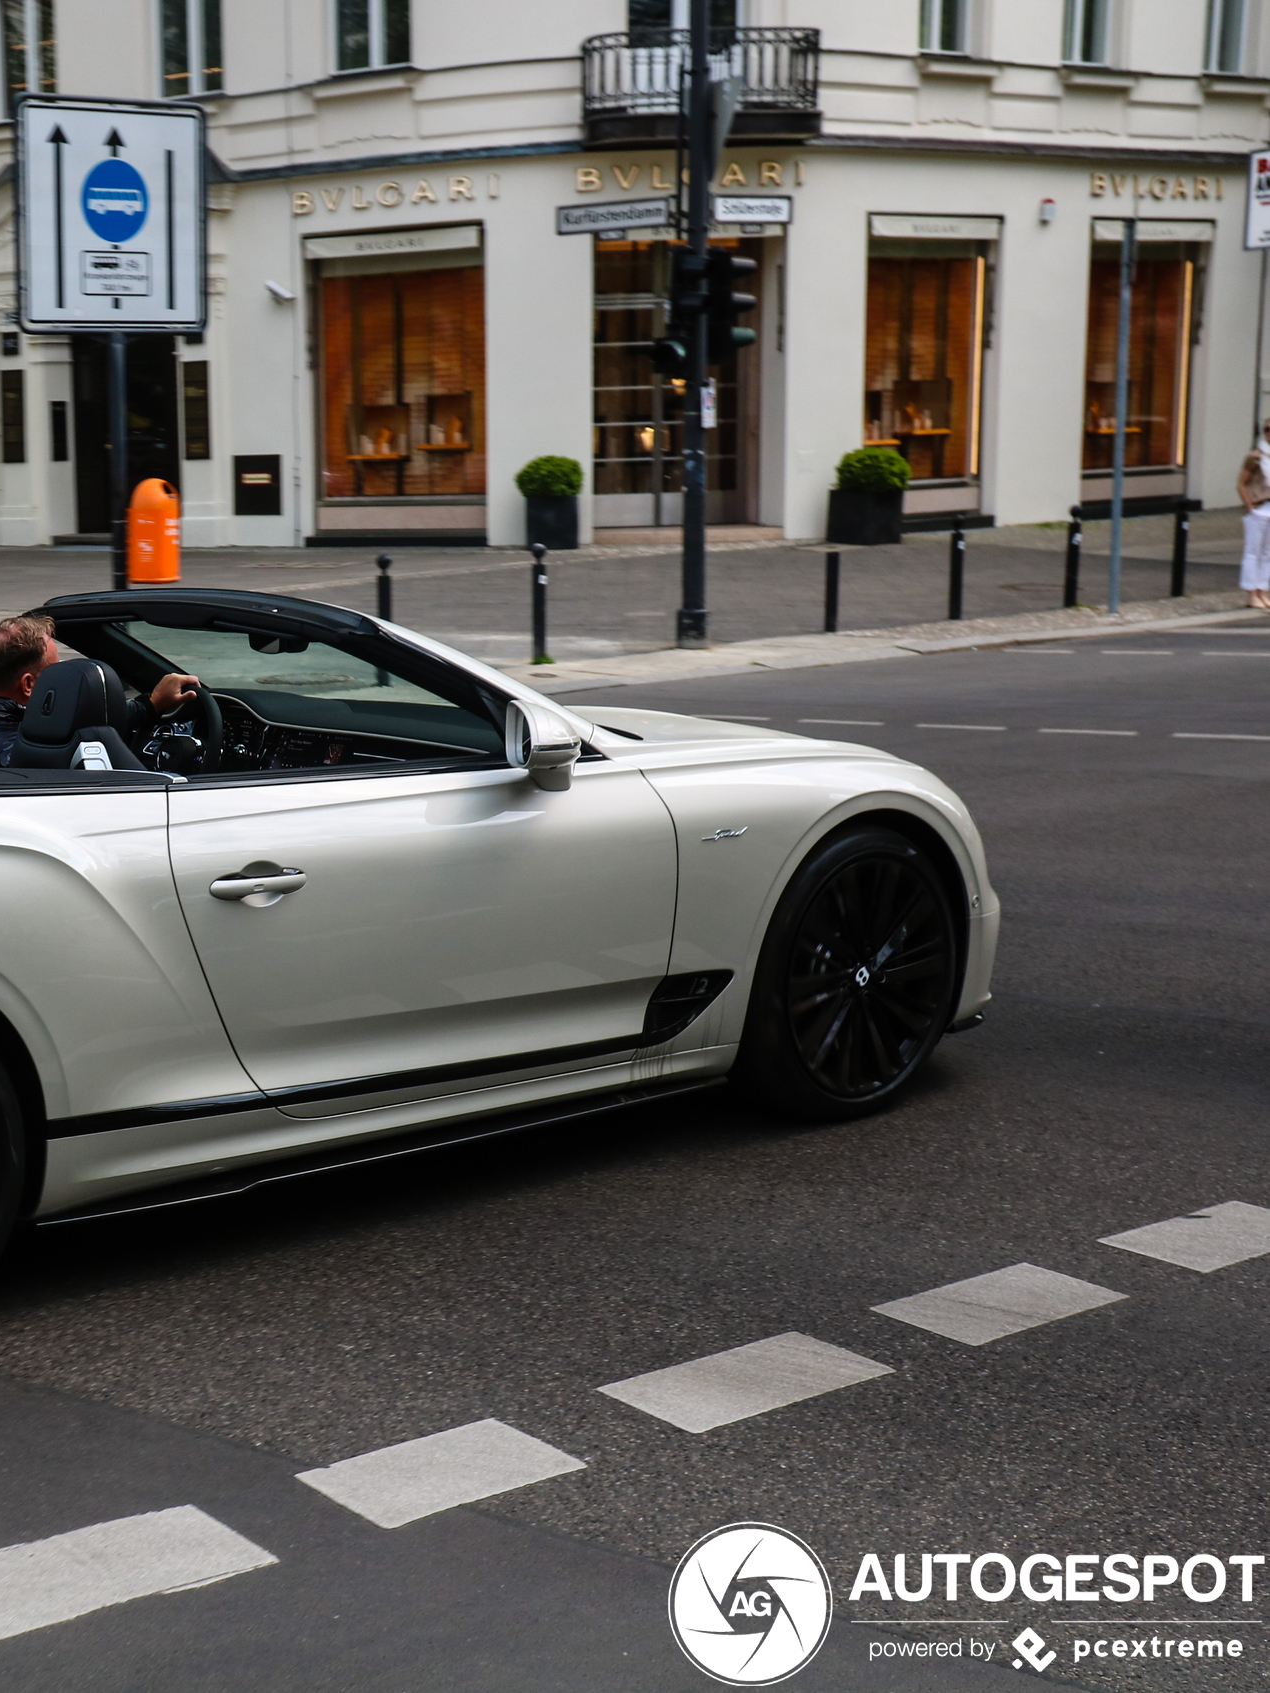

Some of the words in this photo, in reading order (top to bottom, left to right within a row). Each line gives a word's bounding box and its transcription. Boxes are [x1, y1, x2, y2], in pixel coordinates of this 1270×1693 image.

[575, 160, 807, 193] BVLARI
[1090, 172, 1224, 200] BVLGARI
[292, 172, 500, 215] BVLGARI
